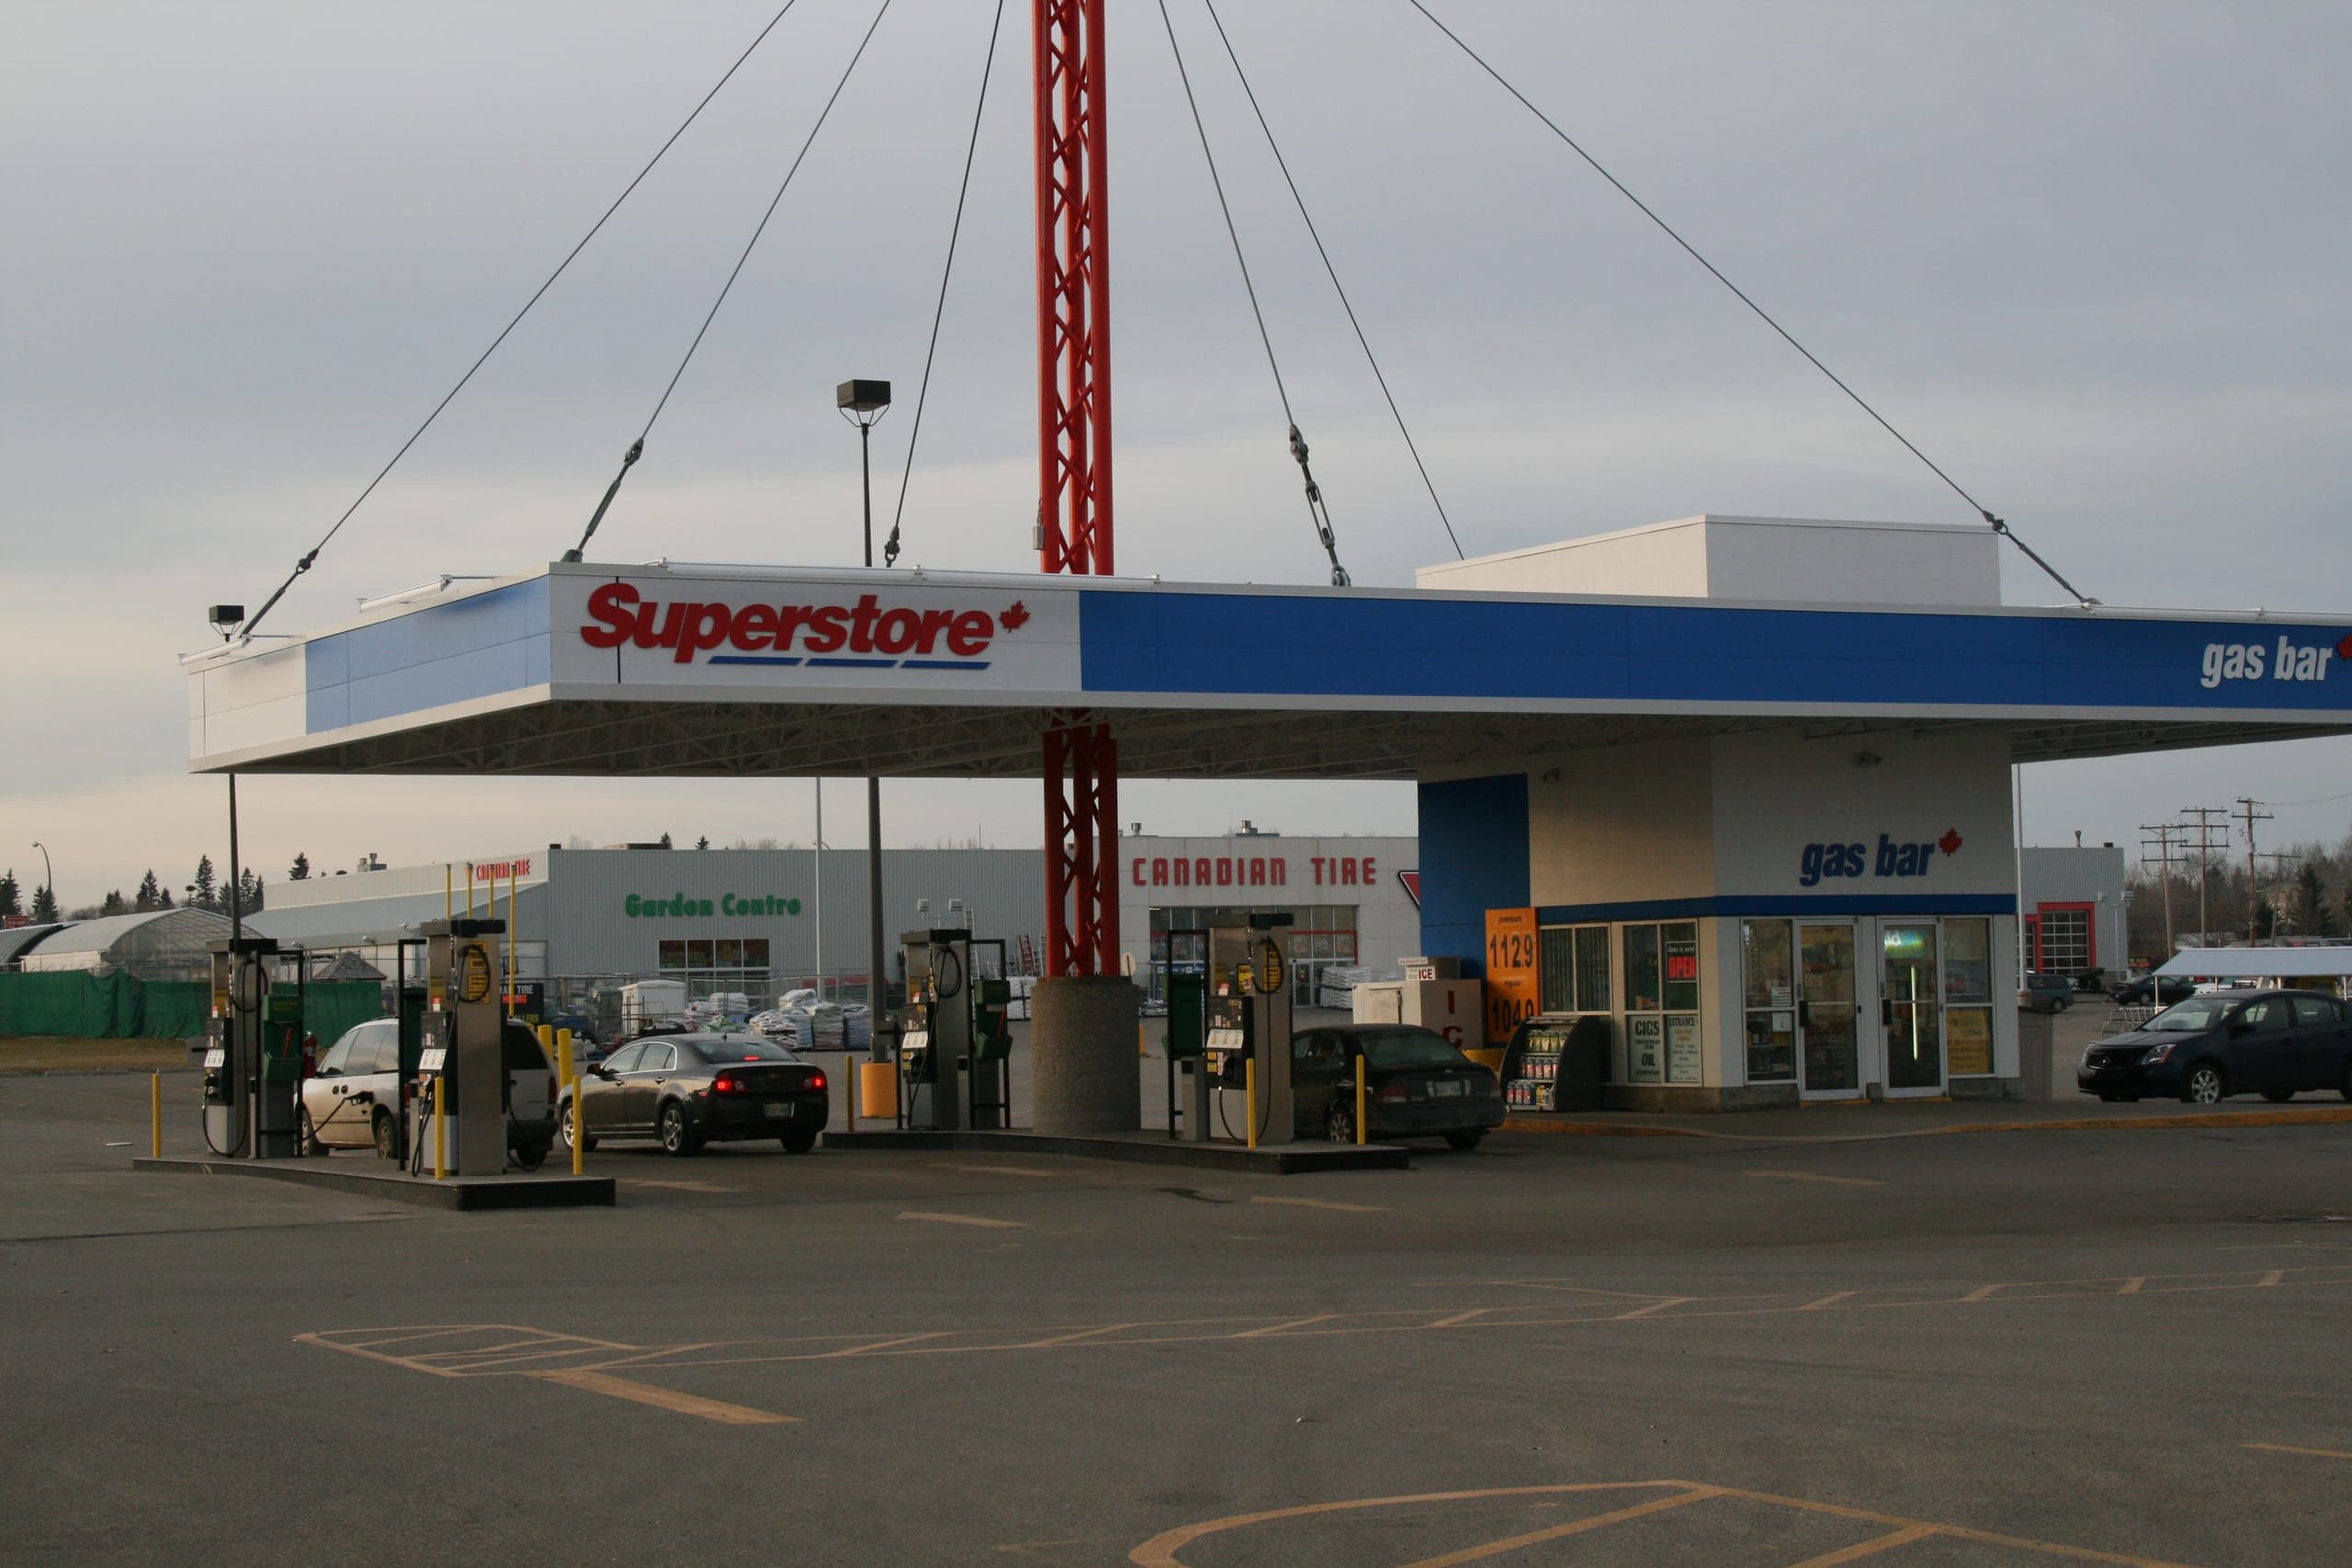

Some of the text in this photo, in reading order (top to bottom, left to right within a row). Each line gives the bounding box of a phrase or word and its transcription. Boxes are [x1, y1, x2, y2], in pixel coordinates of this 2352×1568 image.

[581, 582, 994, 663] Superstore
[2200, 636, 2333, 689] gas bar
[1133, 857, 1376, 886] CANADIAN TIRE
[1800, 833, 1935, 886] gas bar
[626, 892, 801, 918] Garden Centre
[1419, 969, 1434, 980] ICE
[1668, 955, 1696, 979] OPEN
[516, 985, 534, 995] TIRE
[1635, 1020, 1660, 1036] CIGS
[1642, 1054, 1656, 1066] OIL
